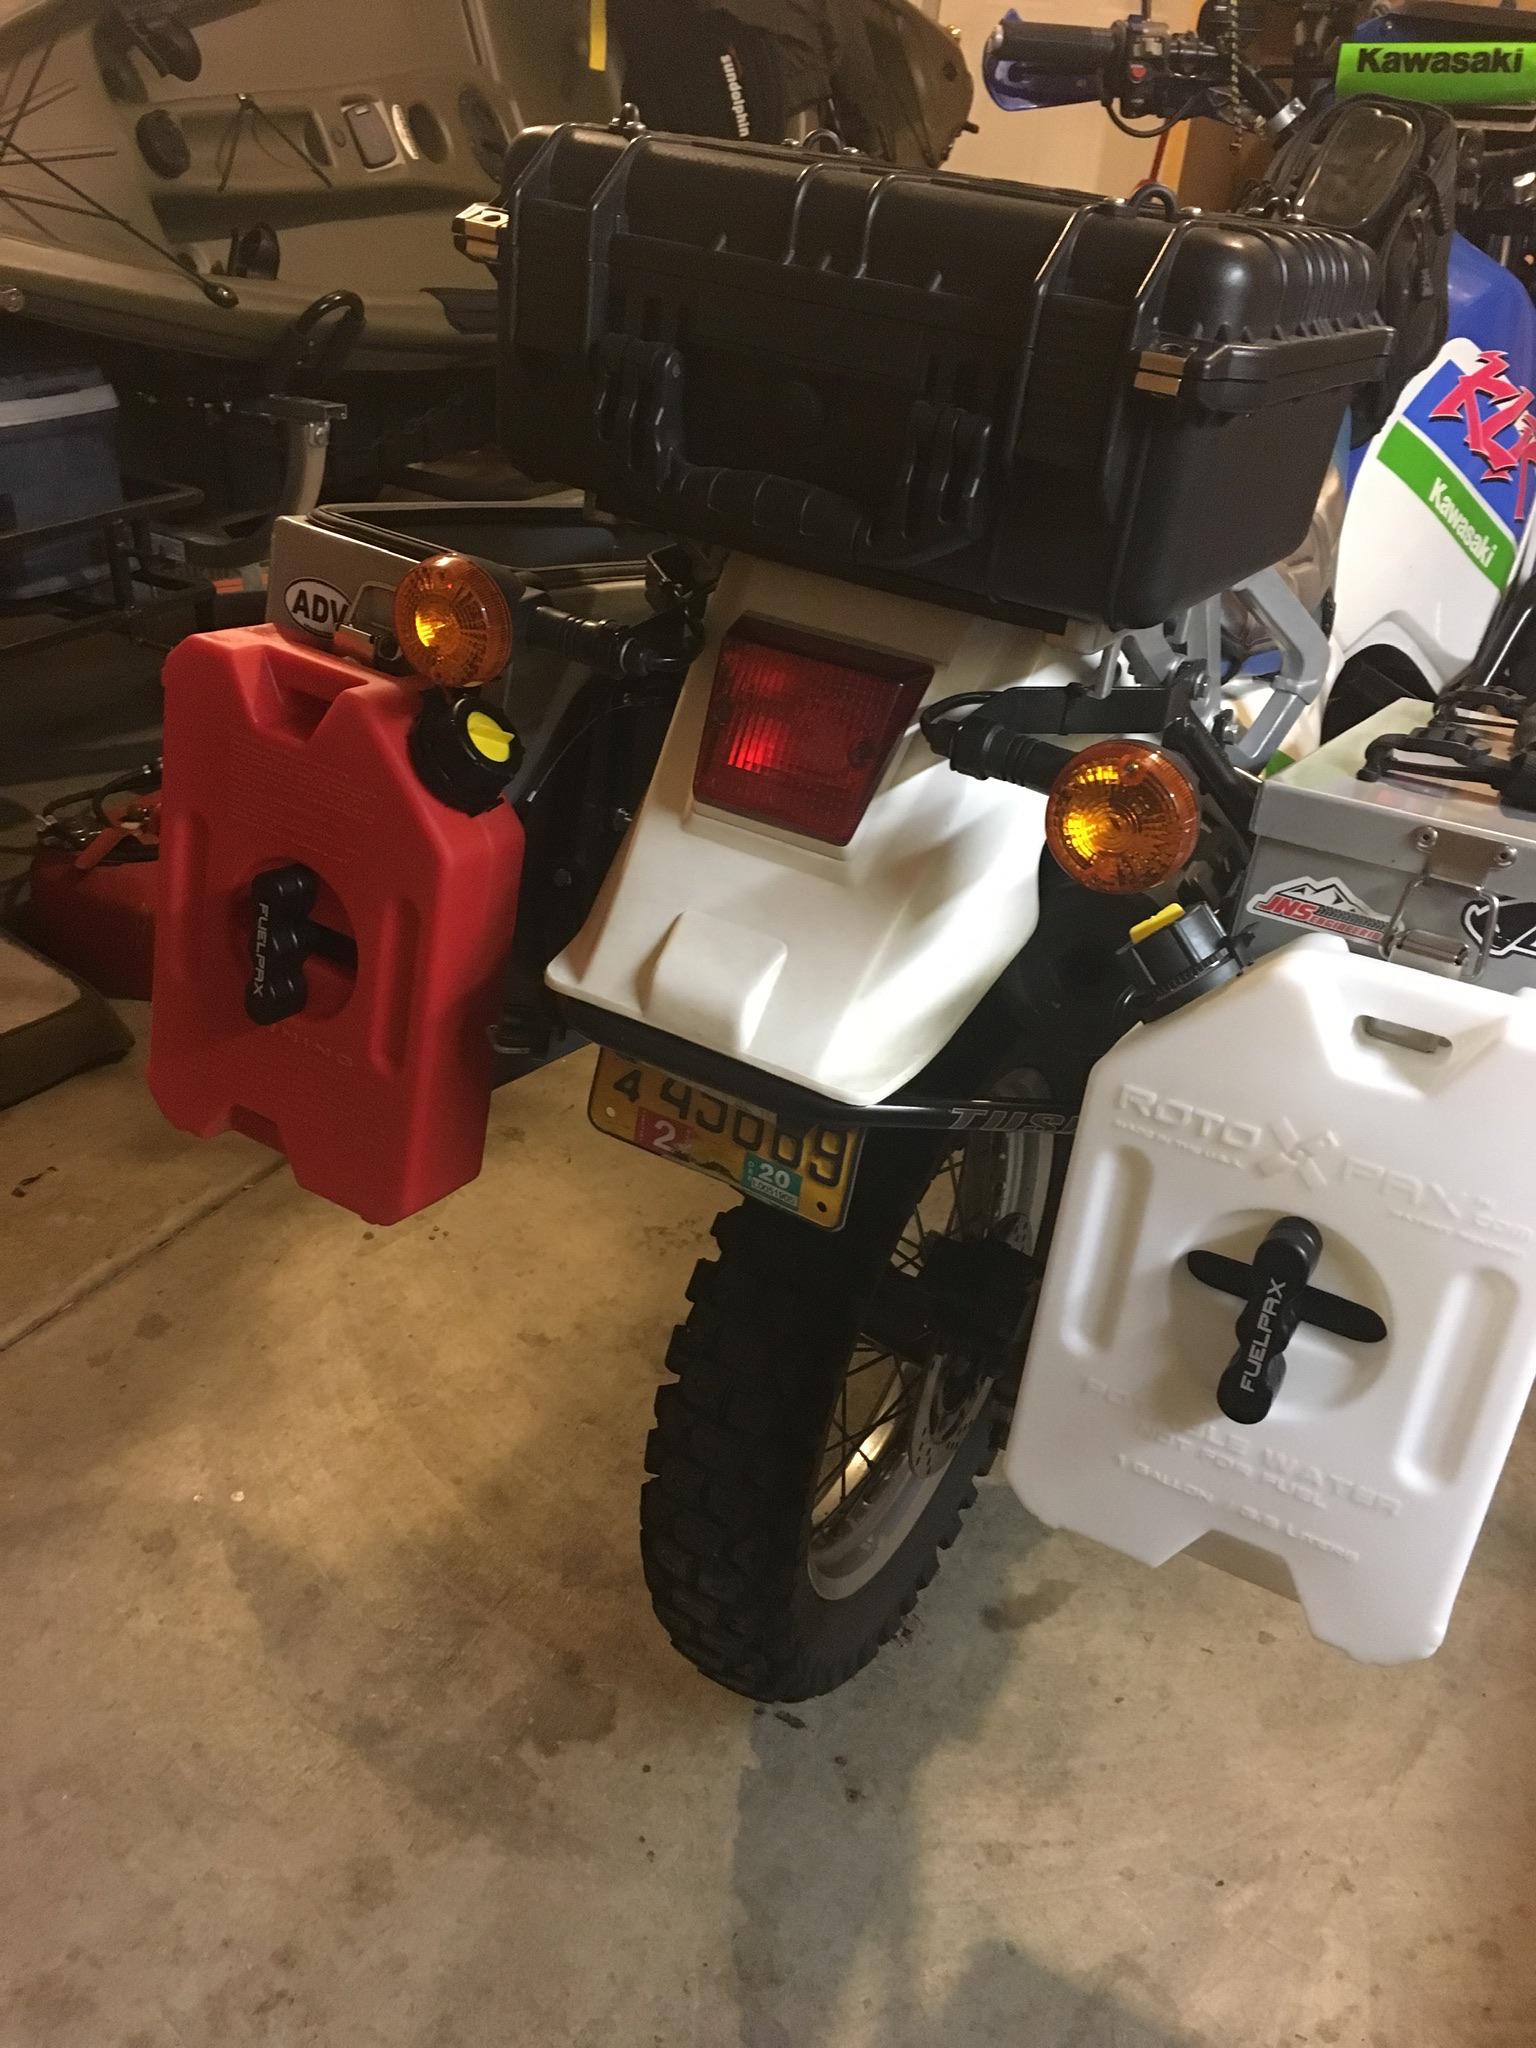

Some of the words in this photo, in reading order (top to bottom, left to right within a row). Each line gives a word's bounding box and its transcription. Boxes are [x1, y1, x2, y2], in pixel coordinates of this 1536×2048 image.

[1356, 47, 1524, 74] Kawasaki
[720, 54, 750, 137] sundolphin
[1428, 476, 1498, 569] Kawasaki
[291, 588, 349, 632] ADV
[1259, 894, 1319, 921] JNS
[252, 902, 270, 998] FUELPAX
[652, 1119, 677, 1153] 2
[1119, 1083, 1263, 1147] ROTO
[758, 1161, 791, 1189] 20
[1240, 1277, 1287, 1393] FUELPAX
